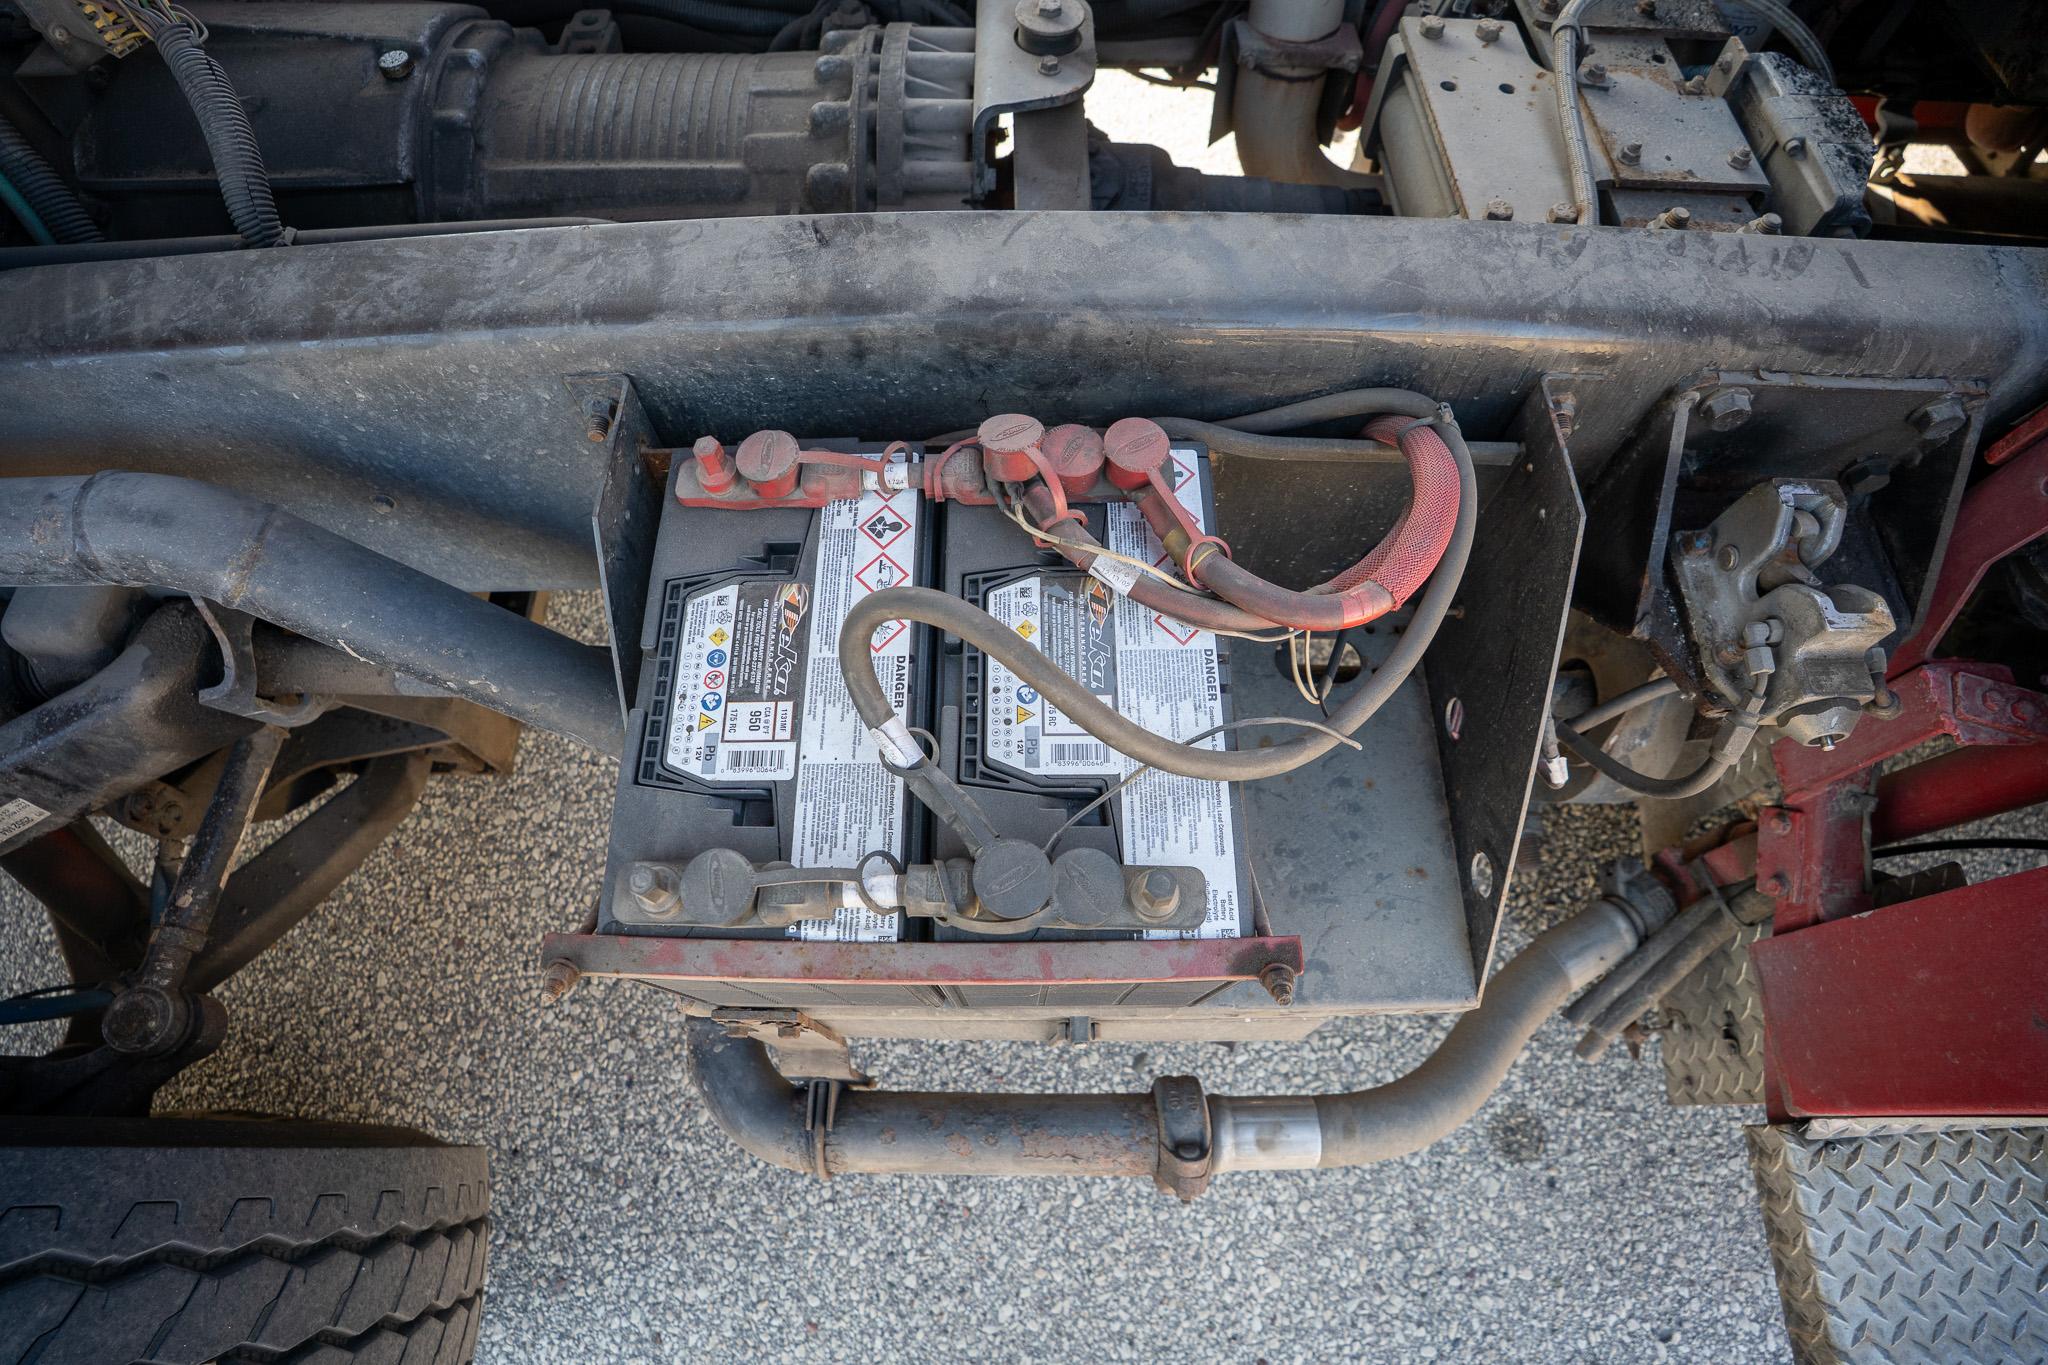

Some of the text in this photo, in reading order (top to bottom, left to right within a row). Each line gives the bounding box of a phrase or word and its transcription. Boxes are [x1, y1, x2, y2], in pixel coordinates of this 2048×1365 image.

[775, 591, 802, 695] Deka
[1079, 594, 1087, 683] MAINTENANCE-FREE
[1087, 582, 1111, 688] Deka
[894, 655, 906, 709] DANGER
[1203, 648, 1218, 702] DANGER
[728, 708, 738, 733] 175 RC
[749, 710, 762, 732] 950
[779, 708, 788, 732] 1131MF
[1048, 716, 1057, 727] RC
[695, 745, 703, 762] 12V
[704, 745, 716, 762] Pb
[1026, 738, 1038, 755] Pb
[887, 817, 895, 831] Lead
[1214, 781, 1227, 857] lectrolyte), Lead Compounds.
[1211, 889, 1220, 921] Electrolyte
[1219, 899, 1227, 921] Battery
[1228, 907, 1236, 921] Acid
